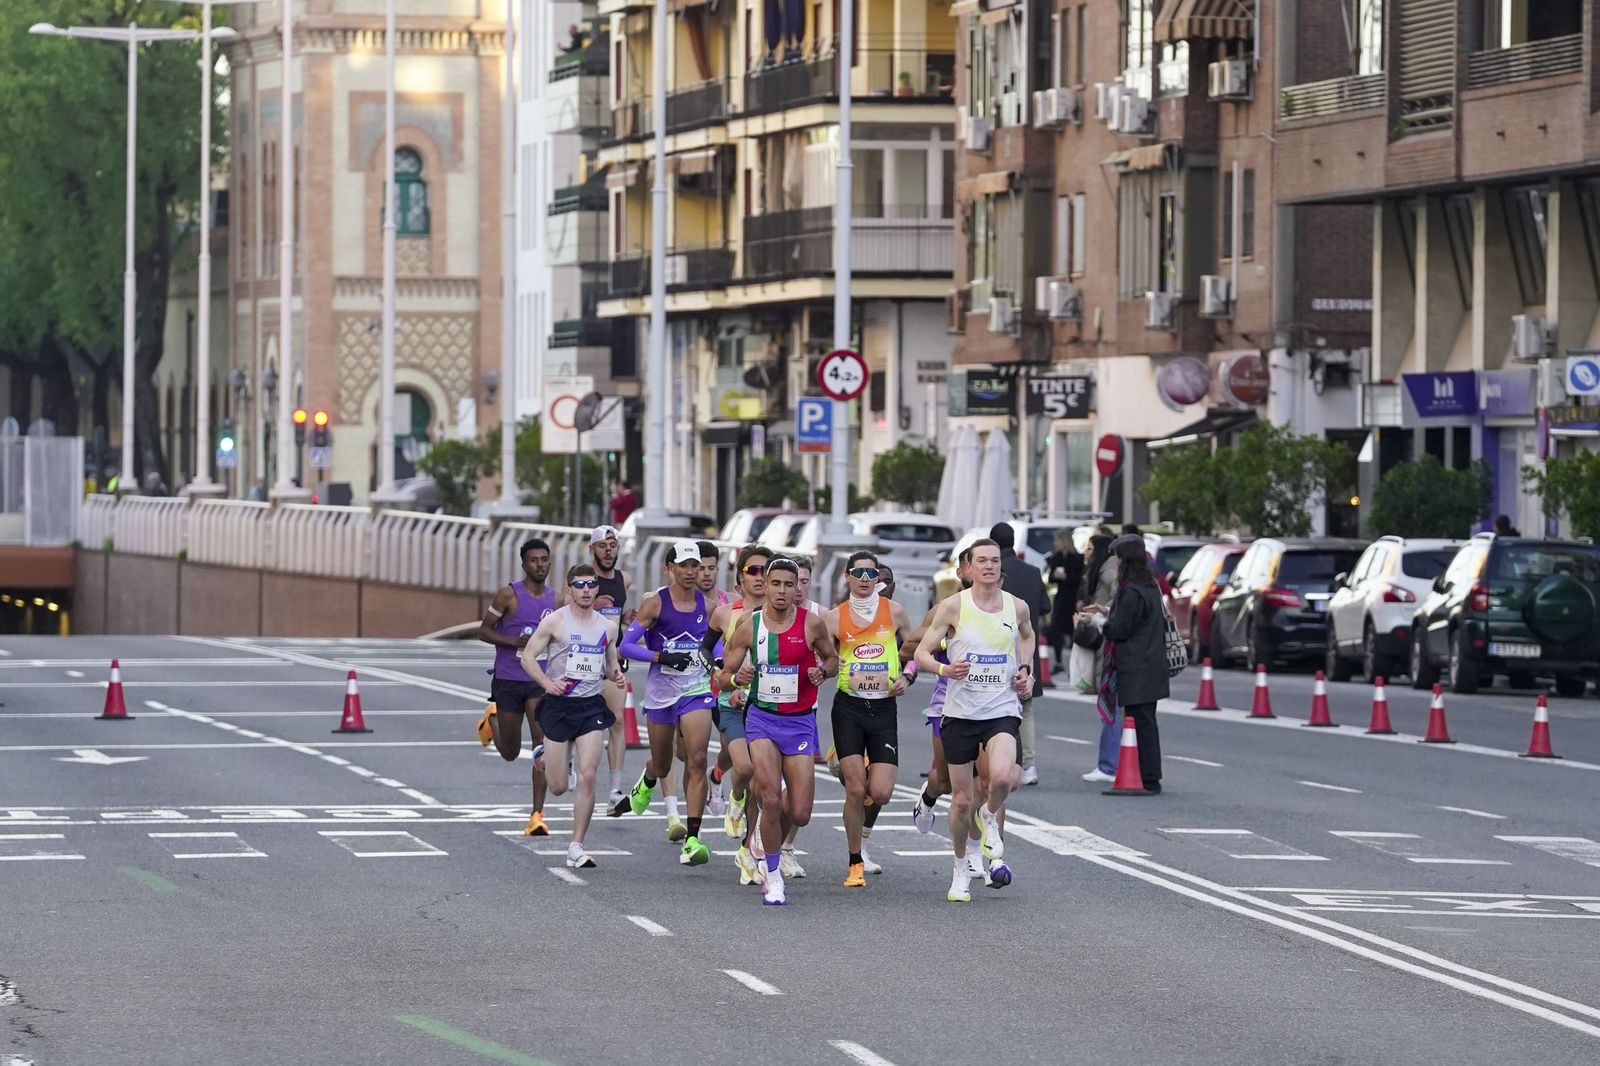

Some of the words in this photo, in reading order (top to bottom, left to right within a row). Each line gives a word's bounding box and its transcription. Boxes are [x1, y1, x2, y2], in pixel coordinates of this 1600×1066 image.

[1028, 379, 1086, 394] TINTE
[1043, 393, 1079, 418] 5€
[801, 402, 825, 433] P
[856, 647, 883, 656] Serrano
[576, 663, 593, 672] PAUL
[968, 673, 1002, 683] CASTEEL
[770, 686, 781, 694] 50
[857, 682, 880, 690] ALAIZ
